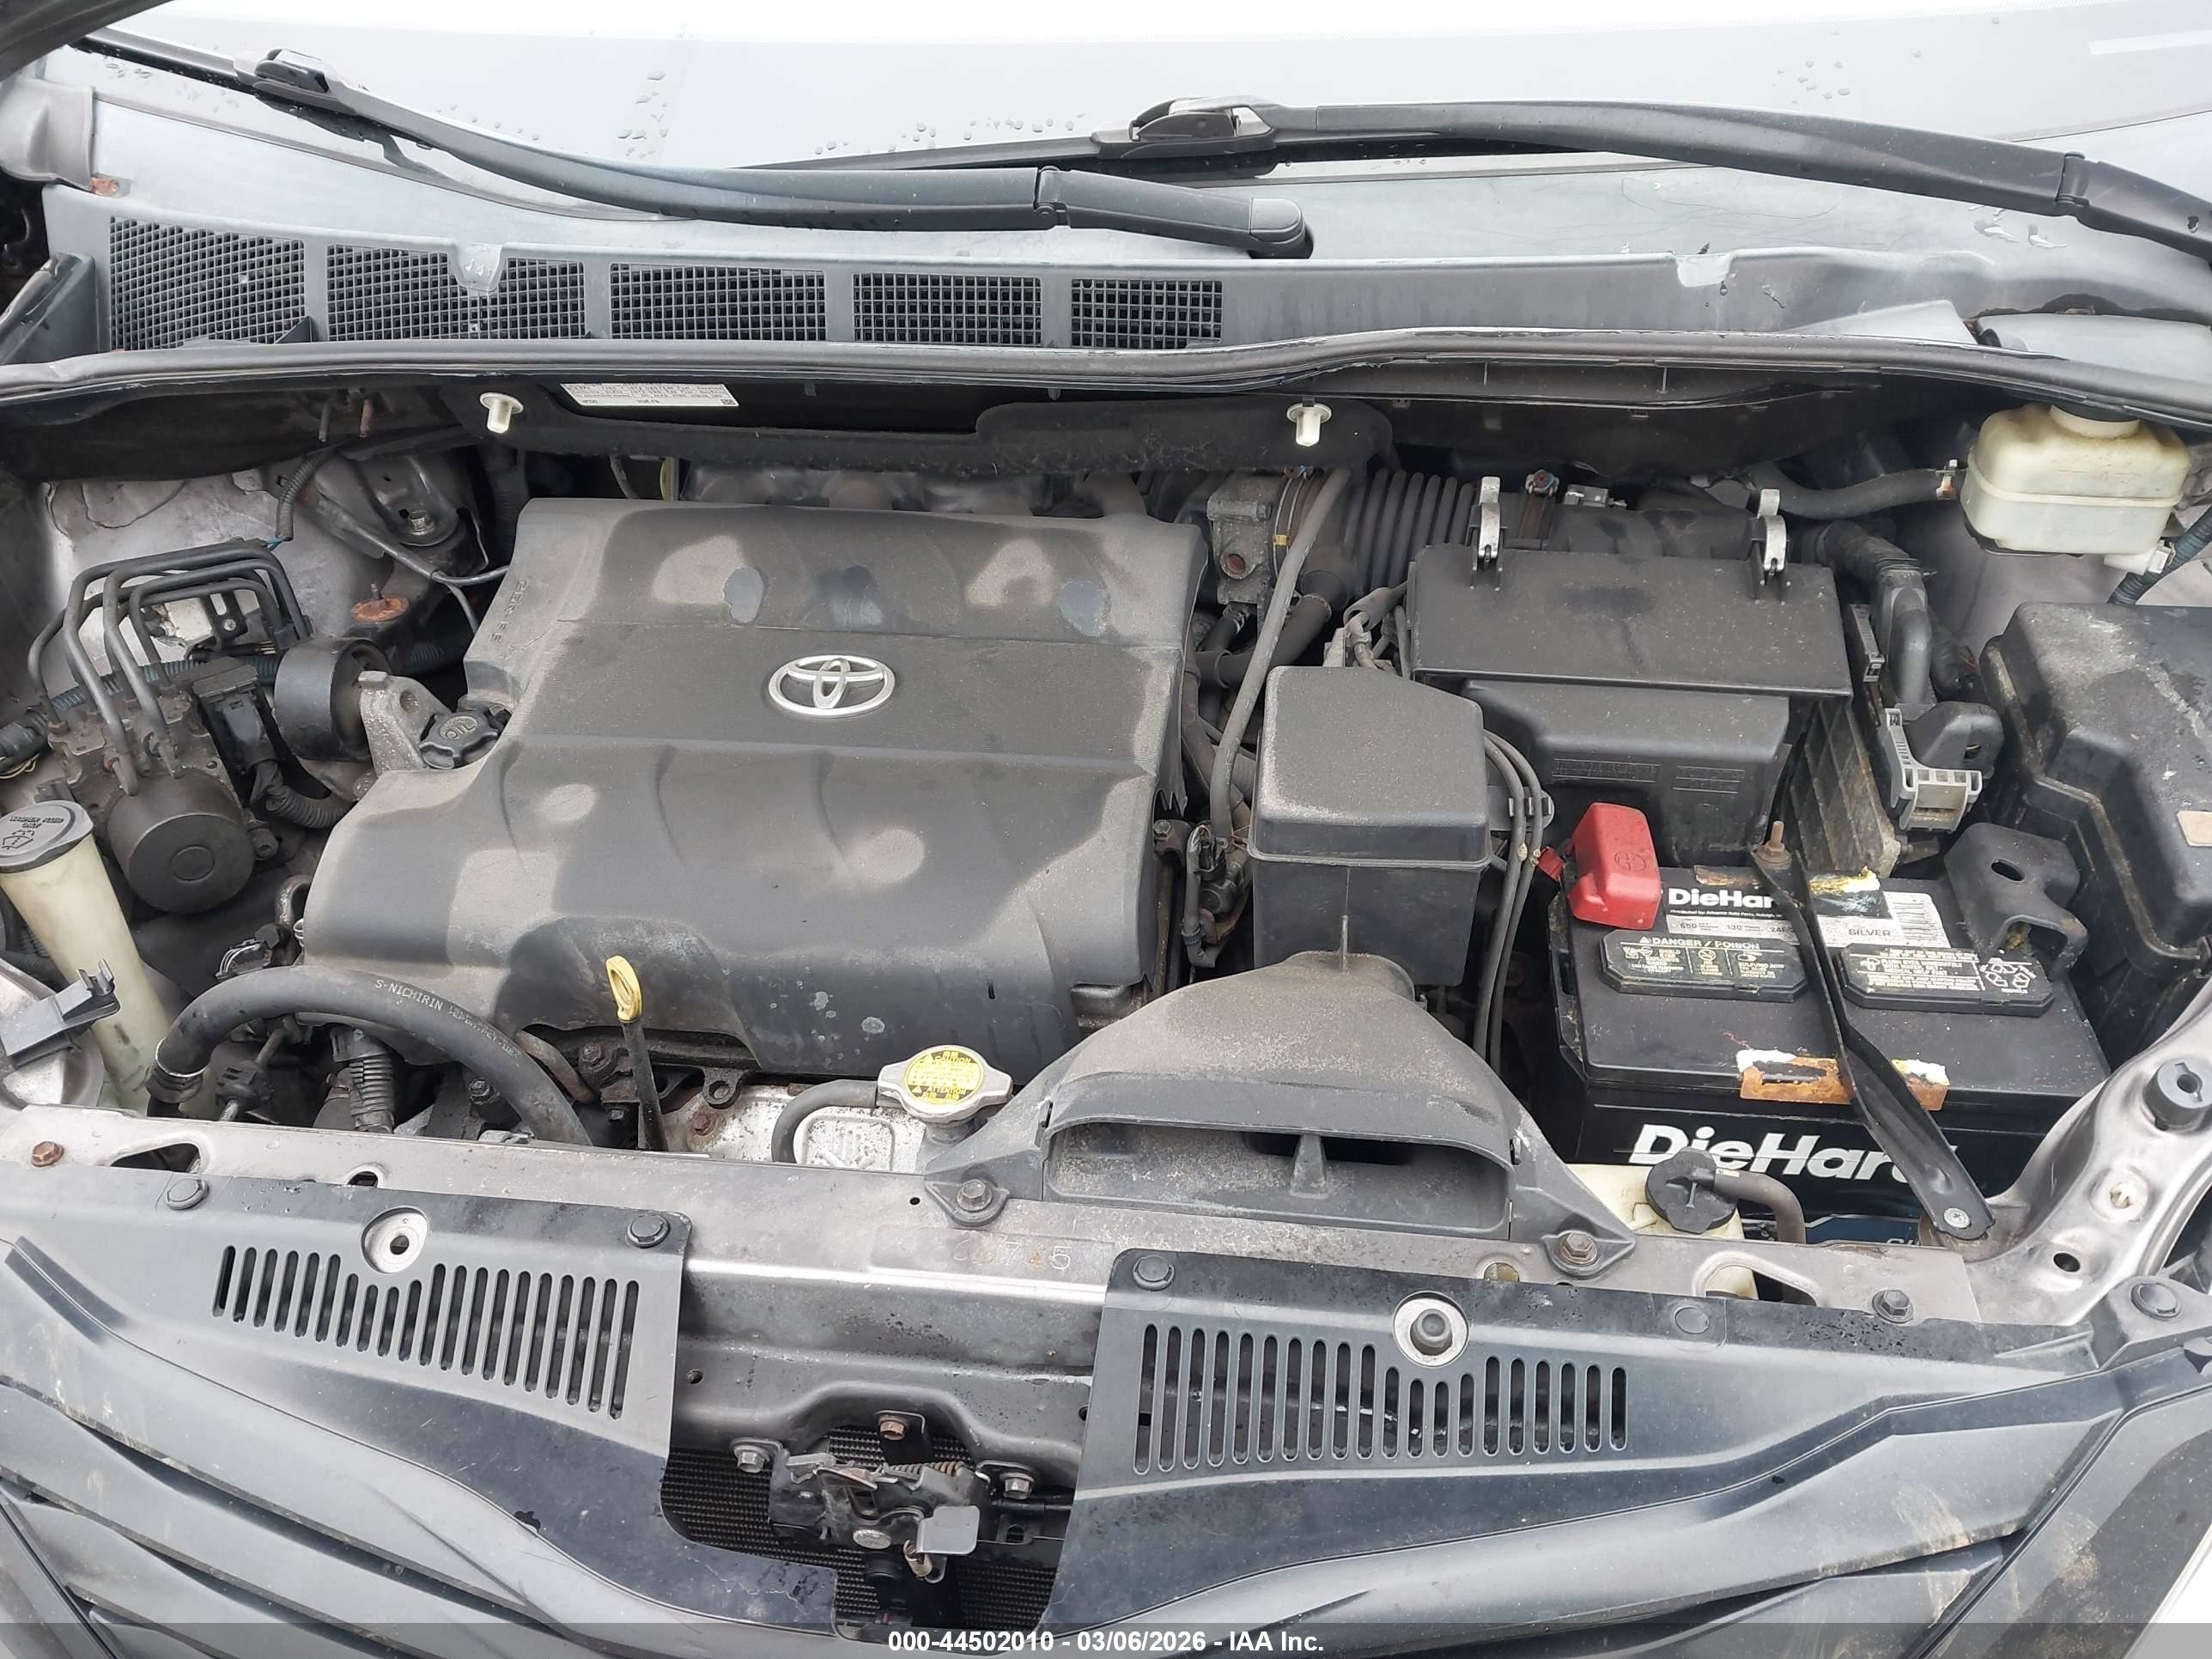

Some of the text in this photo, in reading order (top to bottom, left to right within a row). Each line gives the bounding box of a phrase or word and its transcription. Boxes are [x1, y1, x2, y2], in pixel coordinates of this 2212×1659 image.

[445, 722, 477, 738] OIL
[1668, 888, 1775, 908] DieHar
[1651, 937, 1703, 946] DANGER
[1714, 940, 1760, 950] POISON
[934, 1055, 972, 1064] CAUTION
[927, 1085, 967, 1095] ATTENTION
